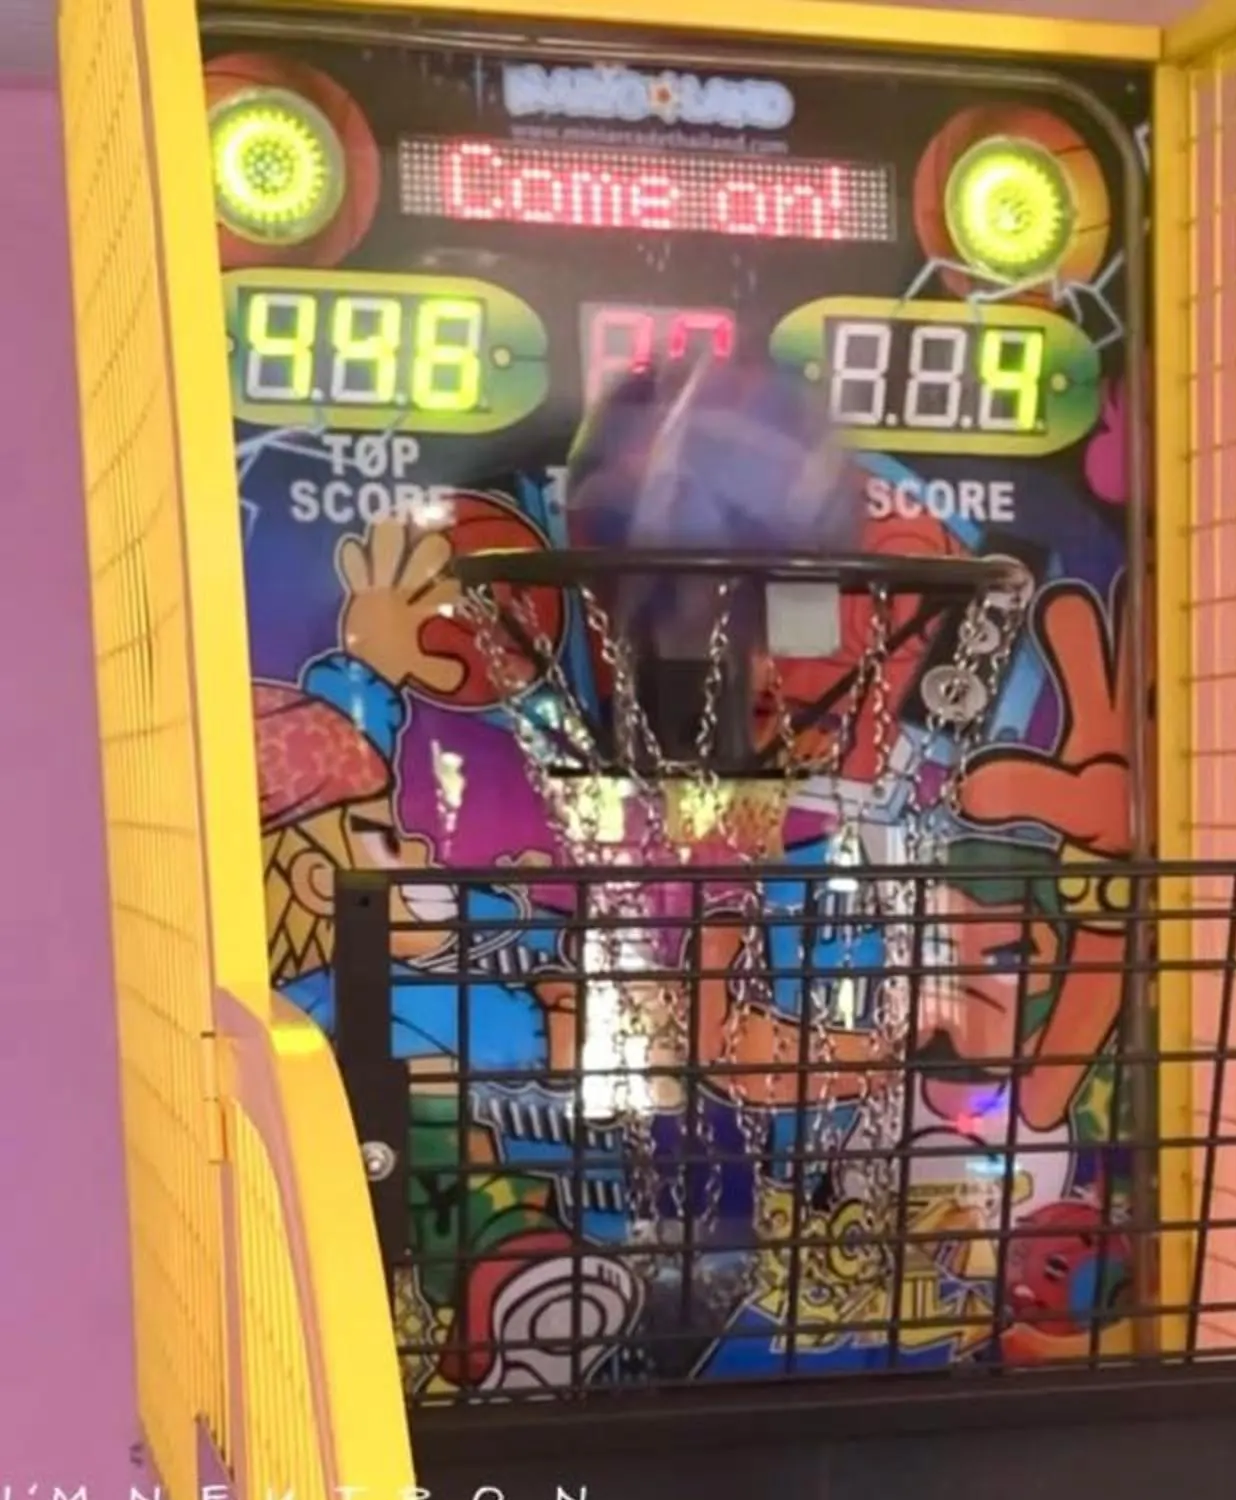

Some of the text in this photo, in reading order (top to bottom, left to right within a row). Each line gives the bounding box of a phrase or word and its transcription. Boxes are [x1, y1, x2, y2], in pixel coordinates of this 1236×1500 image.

[450, 142, 843, 240] Come on!
[322, 433, 420, 479] TOP
[289, 479, 456, 525] SCORE
[865, 477, 1015, 522] SCORE
